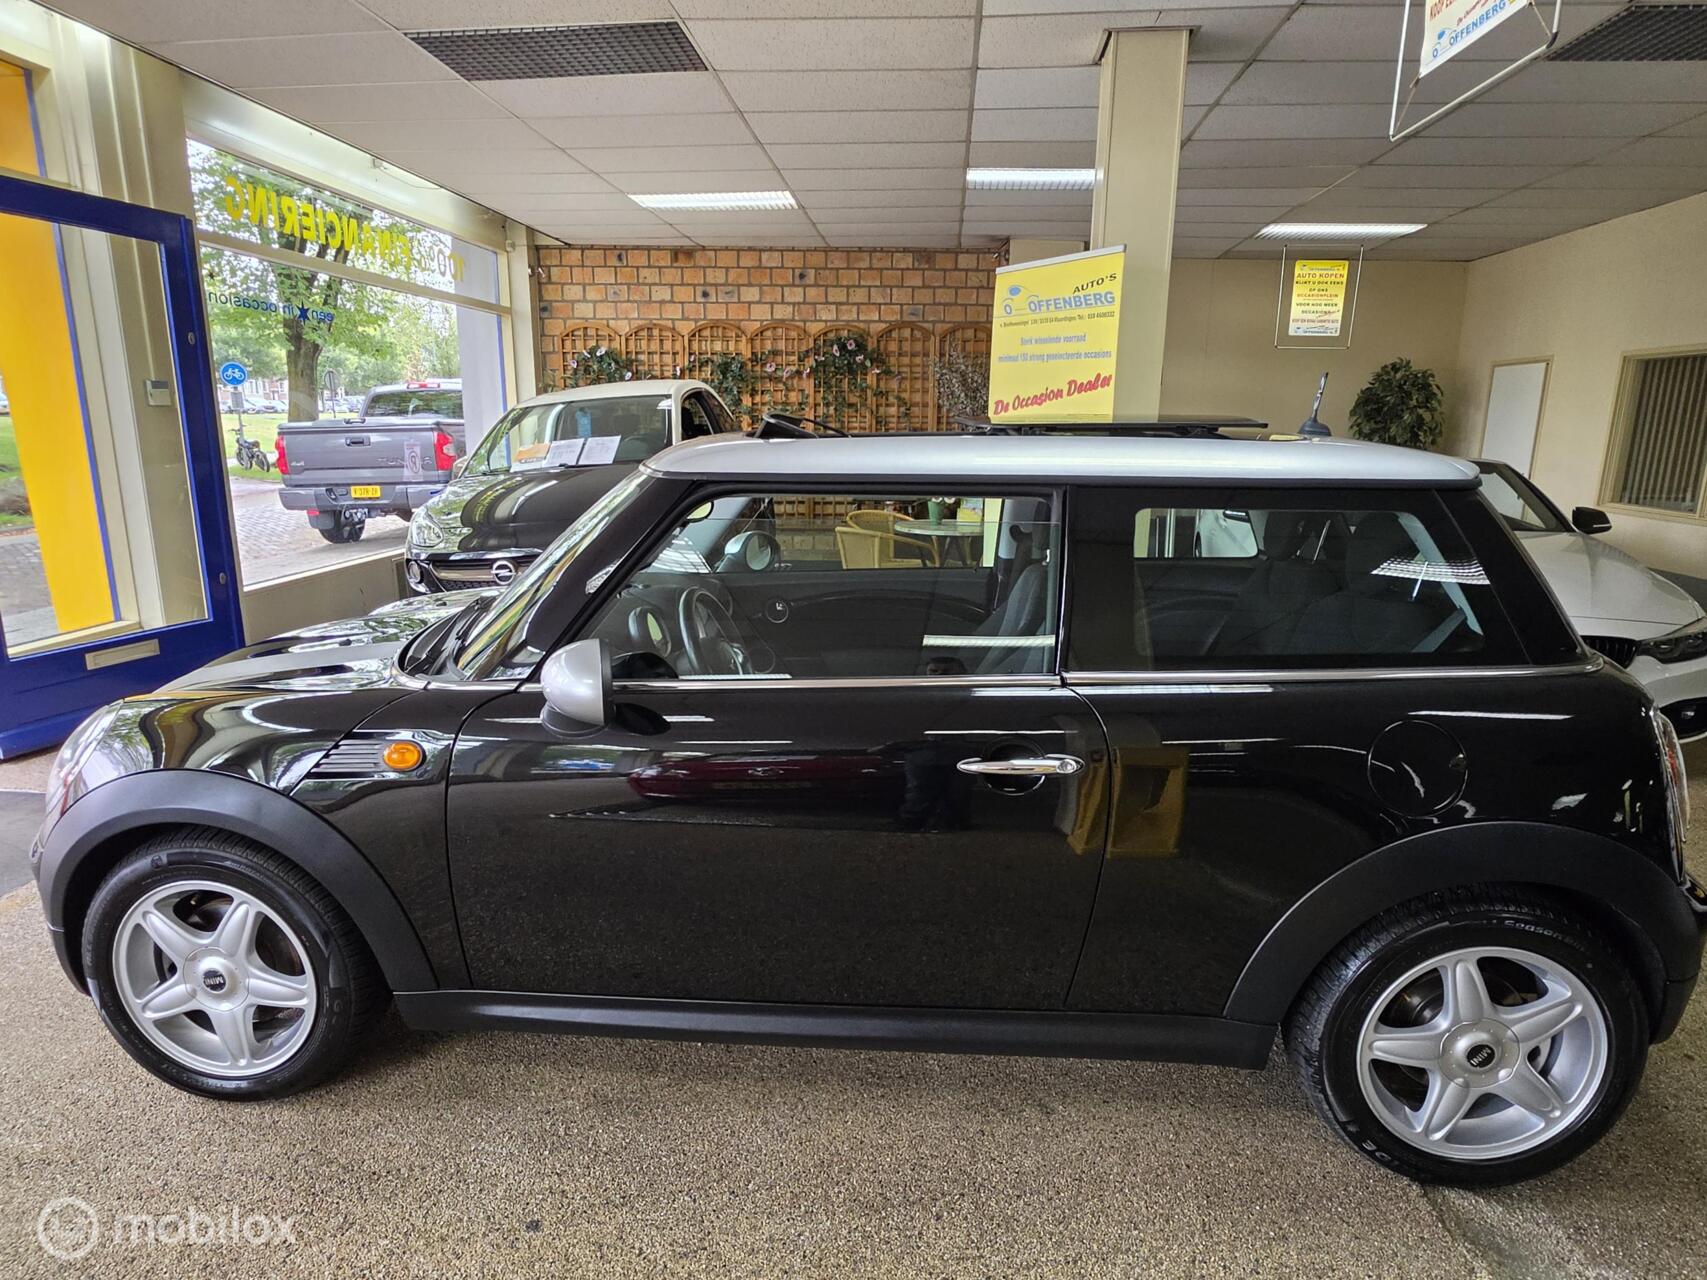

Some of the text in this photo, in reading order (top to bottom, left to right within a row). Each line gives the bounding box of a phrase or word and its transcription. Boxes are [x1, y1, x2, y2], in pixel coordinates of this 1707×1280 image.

[1449, 0, 1506, 46] OFFENBERG
[1072, 272, 1117, 295] AUTO'S
[1028, 291, 1116, 313] OFFENBERG
[1083, 349, 1112, 359] occasions
[993, 372, 1113, 416] De Occasion Dealer
[1470, 1047, 1492, 1066] MINI
